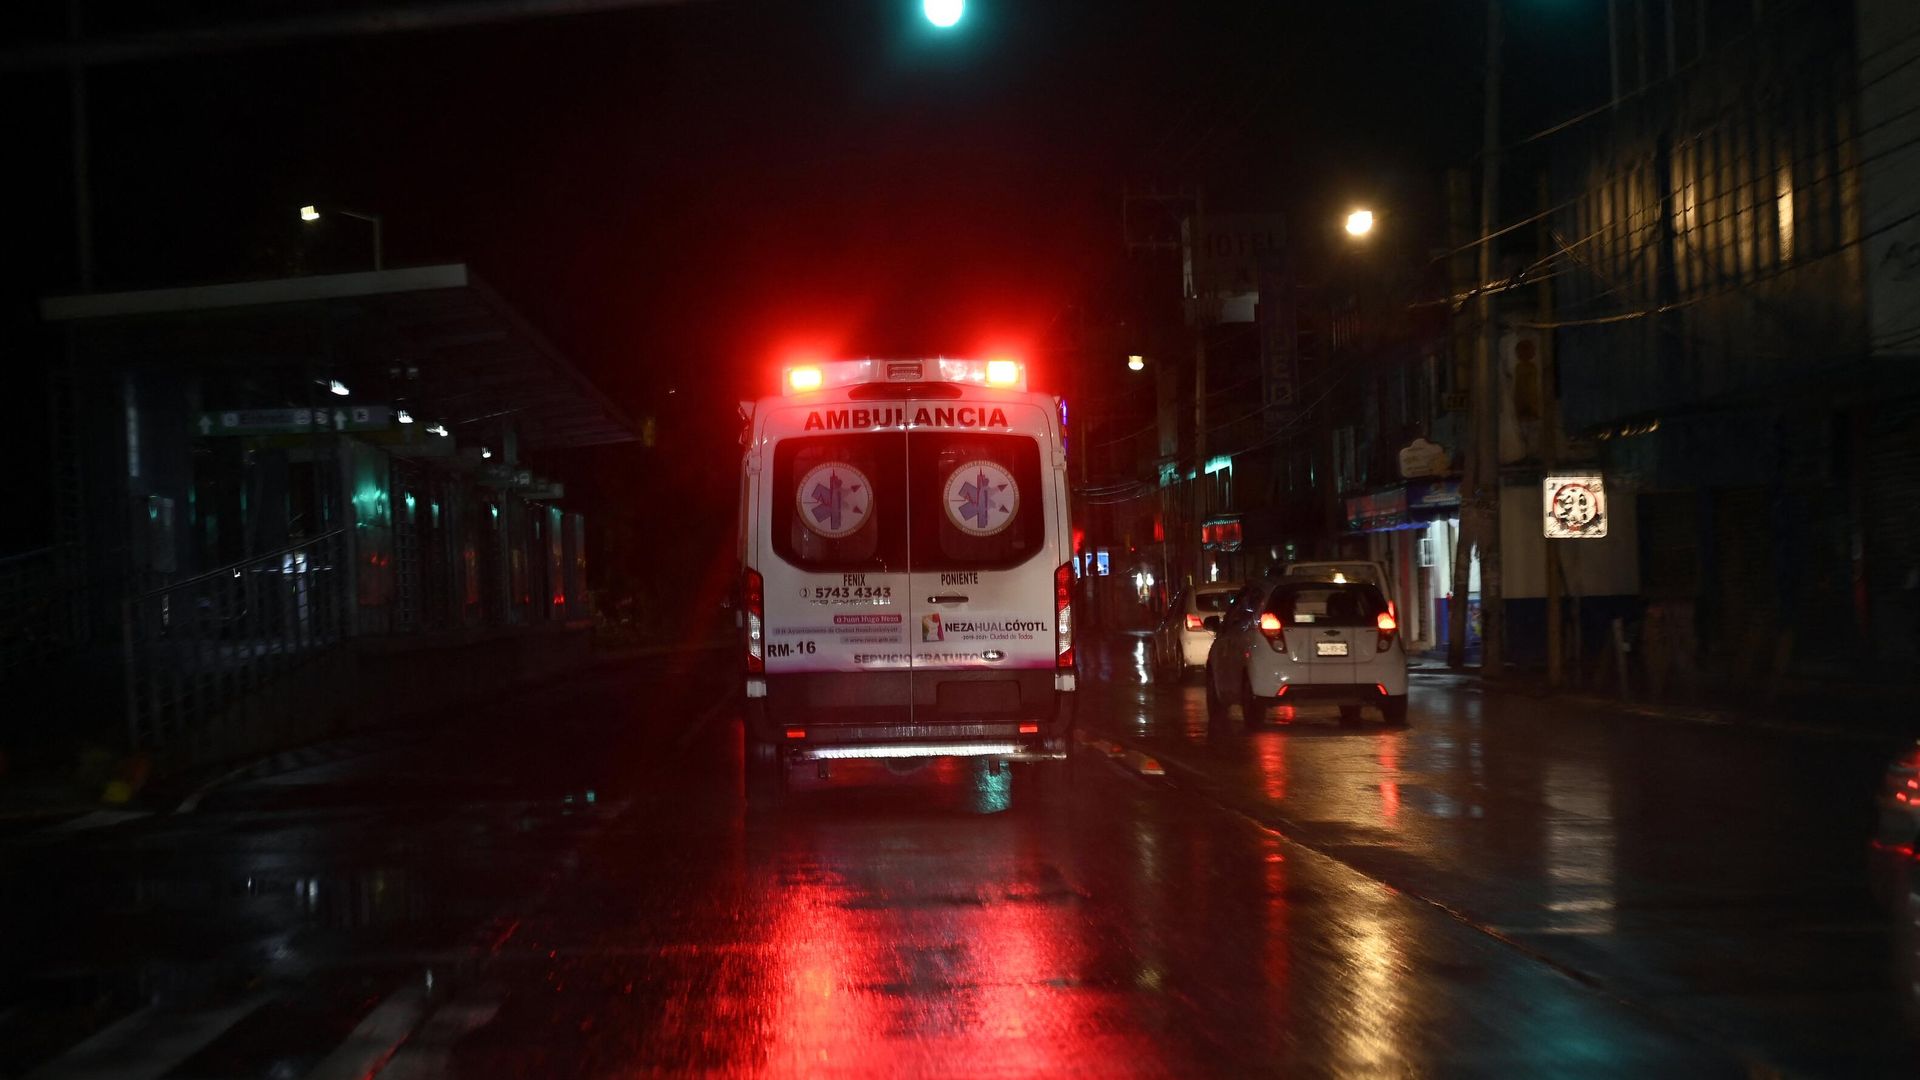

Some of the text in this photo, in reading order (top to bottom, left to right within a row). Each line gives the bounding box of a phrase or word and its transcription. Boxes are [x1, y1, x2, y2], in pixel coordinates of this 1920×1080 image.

[804, 406, 1009, 431] AMBULANCIA
[843, 573, 866, 587] FENIX
[941, 572, 978, 585] PONIENTE
[815, 587, 891, 598] 5743 4343
[945, 619, 1048, 632] NEZAHUALCÓYOTL
